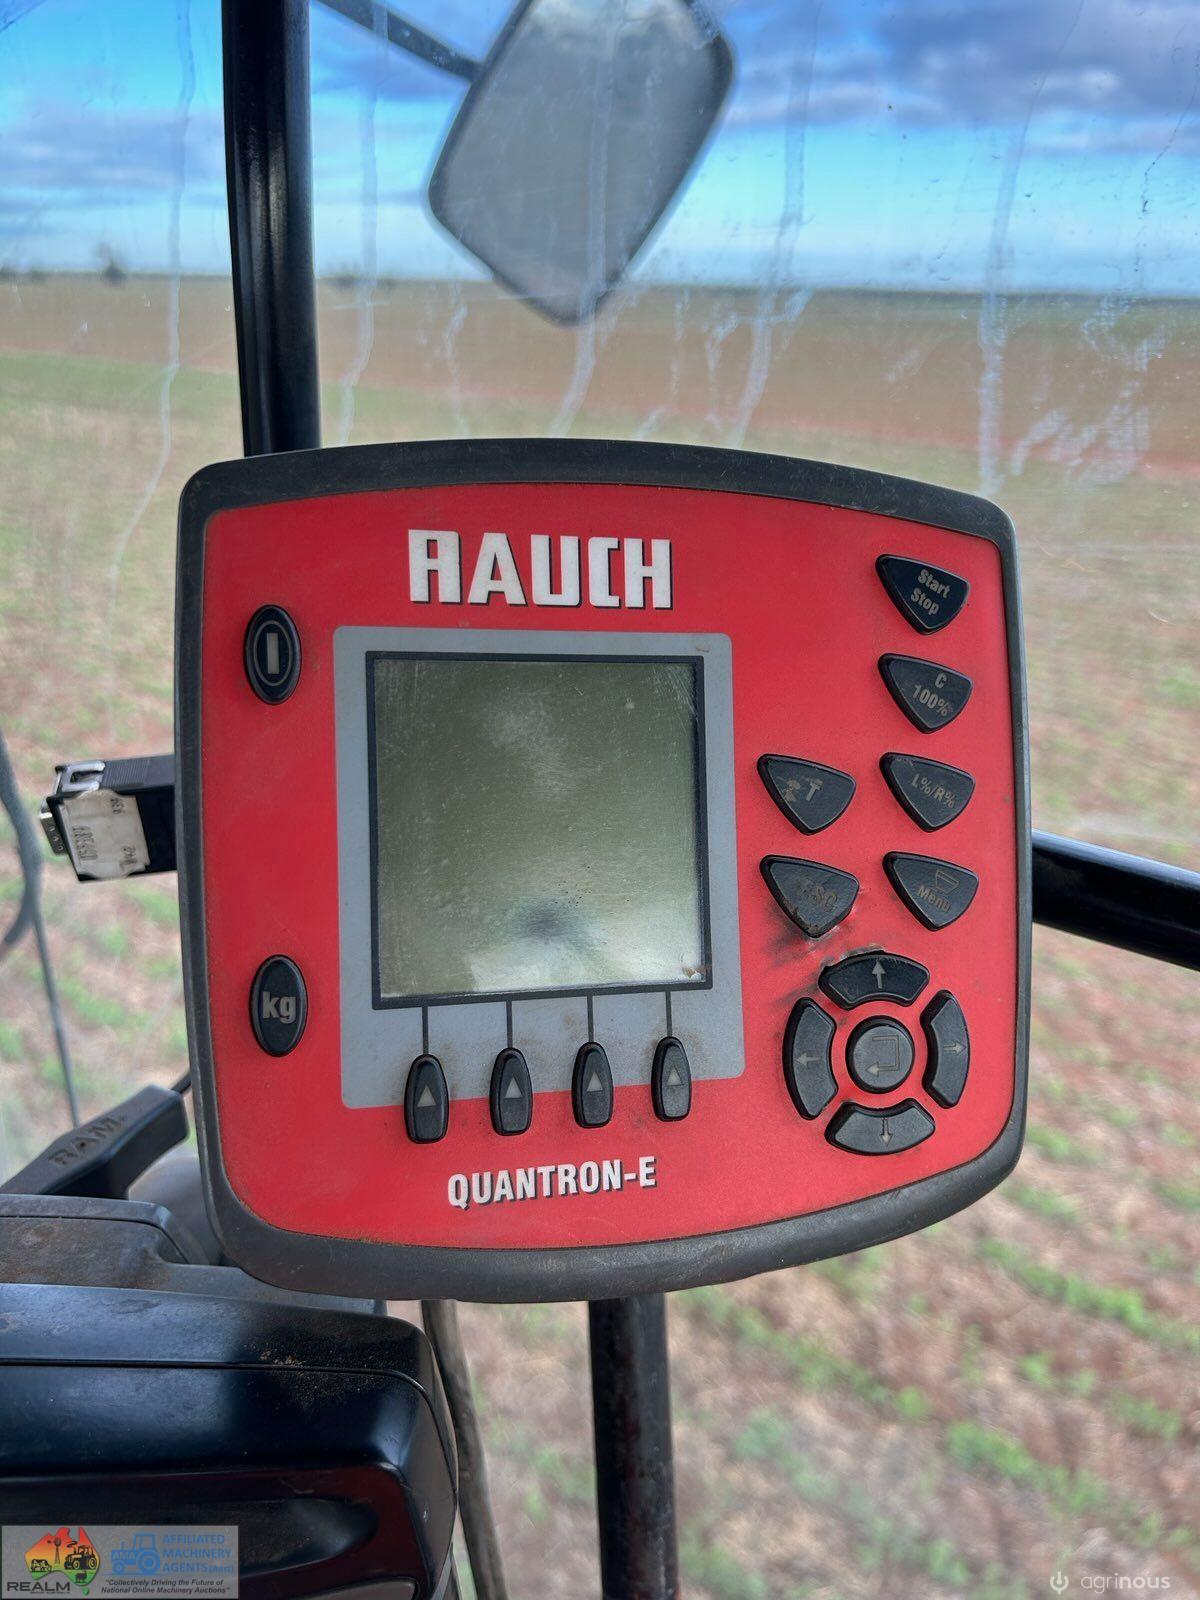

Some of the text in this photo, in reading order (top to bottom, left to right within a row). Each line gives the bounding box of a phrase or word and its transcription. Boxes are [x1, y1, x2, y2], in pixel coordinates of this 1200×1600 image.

[408, 529, 672, 609] RAUCH
[918, 568, 950, 599] Start
[910, 587, 939, 615] Stop
[934, 672, 948, 689] C
[912, 684, 953, 717] 100%
[916, 884, 951, 913] Menu
[262, 991, 297, 1024] kg
[447, 1156, 656, 1210] QUANTRON-E
